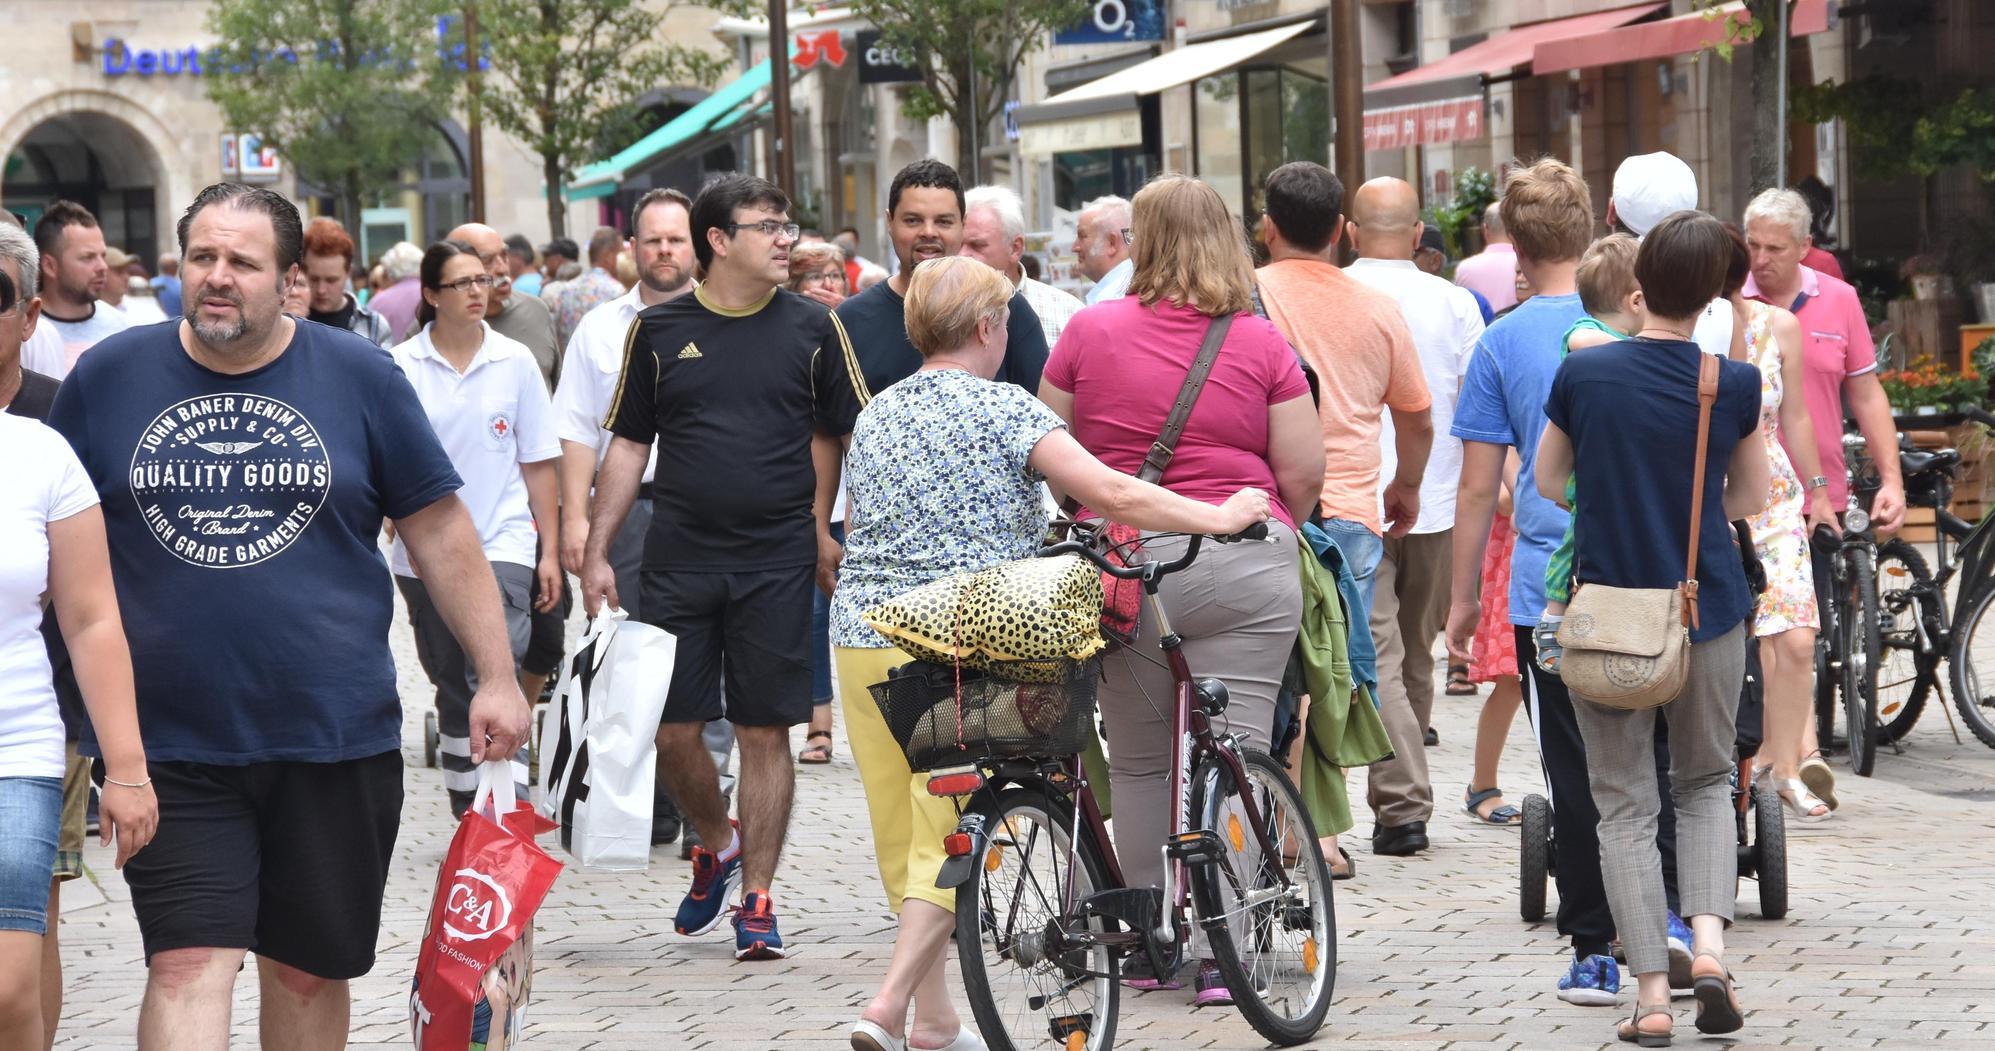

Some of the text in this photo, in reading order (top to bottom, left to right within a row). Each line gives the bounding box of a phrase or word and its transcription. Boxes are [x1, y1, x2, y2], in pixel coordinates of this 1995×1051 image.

[142, 397, 319, 454] JOHN BANER DENIM DIV.
[175, 416, 239, 445] SUPPLY
[246, 420, 258, 433] &
[133, 462, 327, 489] QUALITY GOODS
[178, 504, 275, 525] Original Denim
[201, 520, 251, 535] Brand
[145, 501, 313, 564] HIGH GRADE GARMENTS
[448, 883, 493, 931] C&A
[447, 947, 483, 971] FASHION
